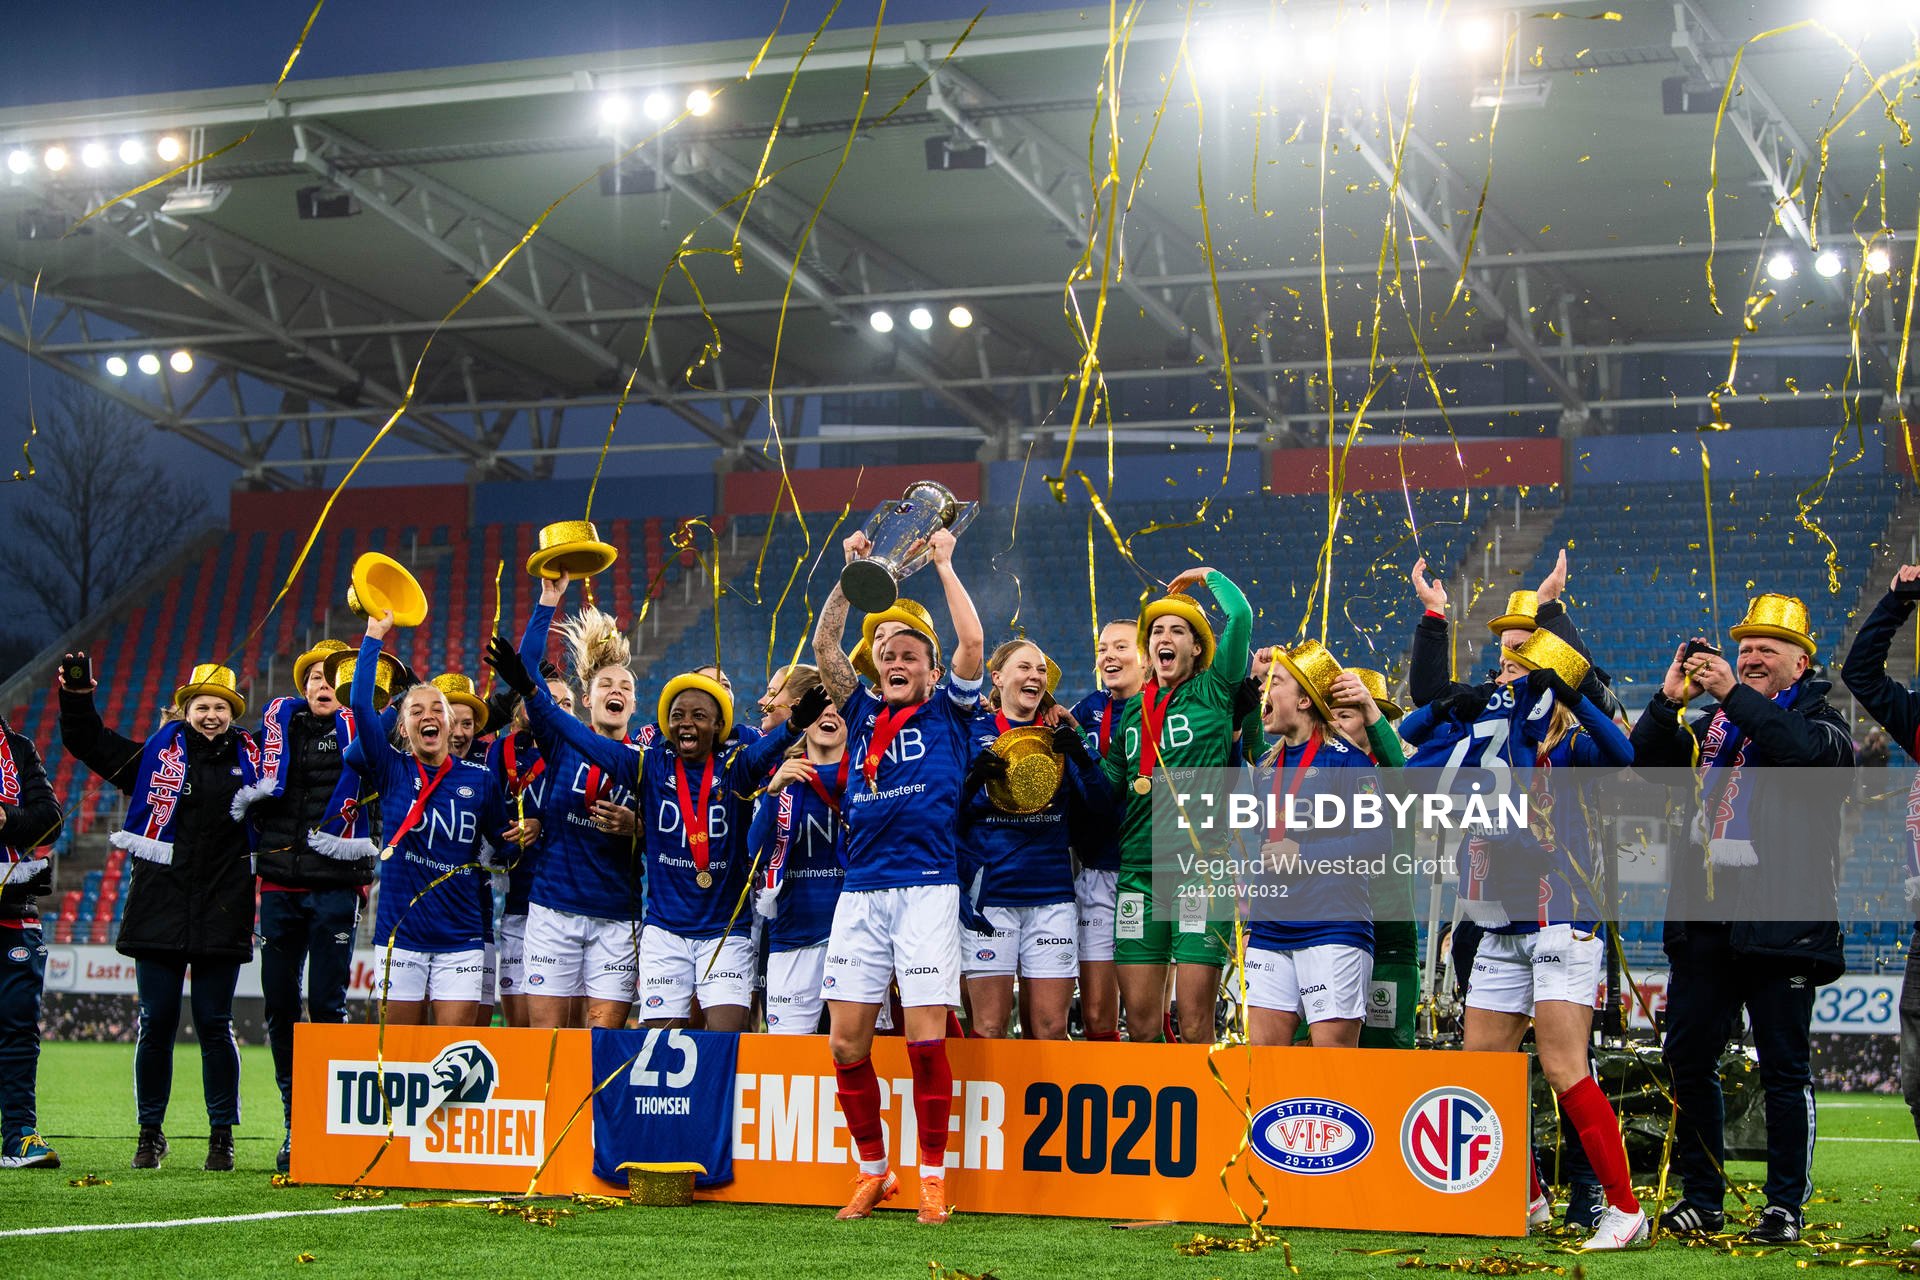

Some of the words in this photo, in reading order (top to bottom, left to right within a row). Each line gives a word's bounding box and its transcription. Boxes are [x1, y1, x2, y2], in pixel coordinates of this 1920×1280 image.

[1036, 937, 1074, 946] ŠKODA
[904, 966, 940, 977] ŠKODA
[337, 1071, 430, 1127] TOPP
[634, 1096, 691, 1115] THOMSEN
[1276, 1103, 1345, 1119] STIFTET
[425, 1106, 536, 1157] SERIEN
[1023, 1081, 1198, 1178] 2020
[1471, 1125, 1488, 1133] 1902
[1284, 1154, 1334, 1168] 29-7-13
[1451, 1177, 1481, 1192] NORGES
